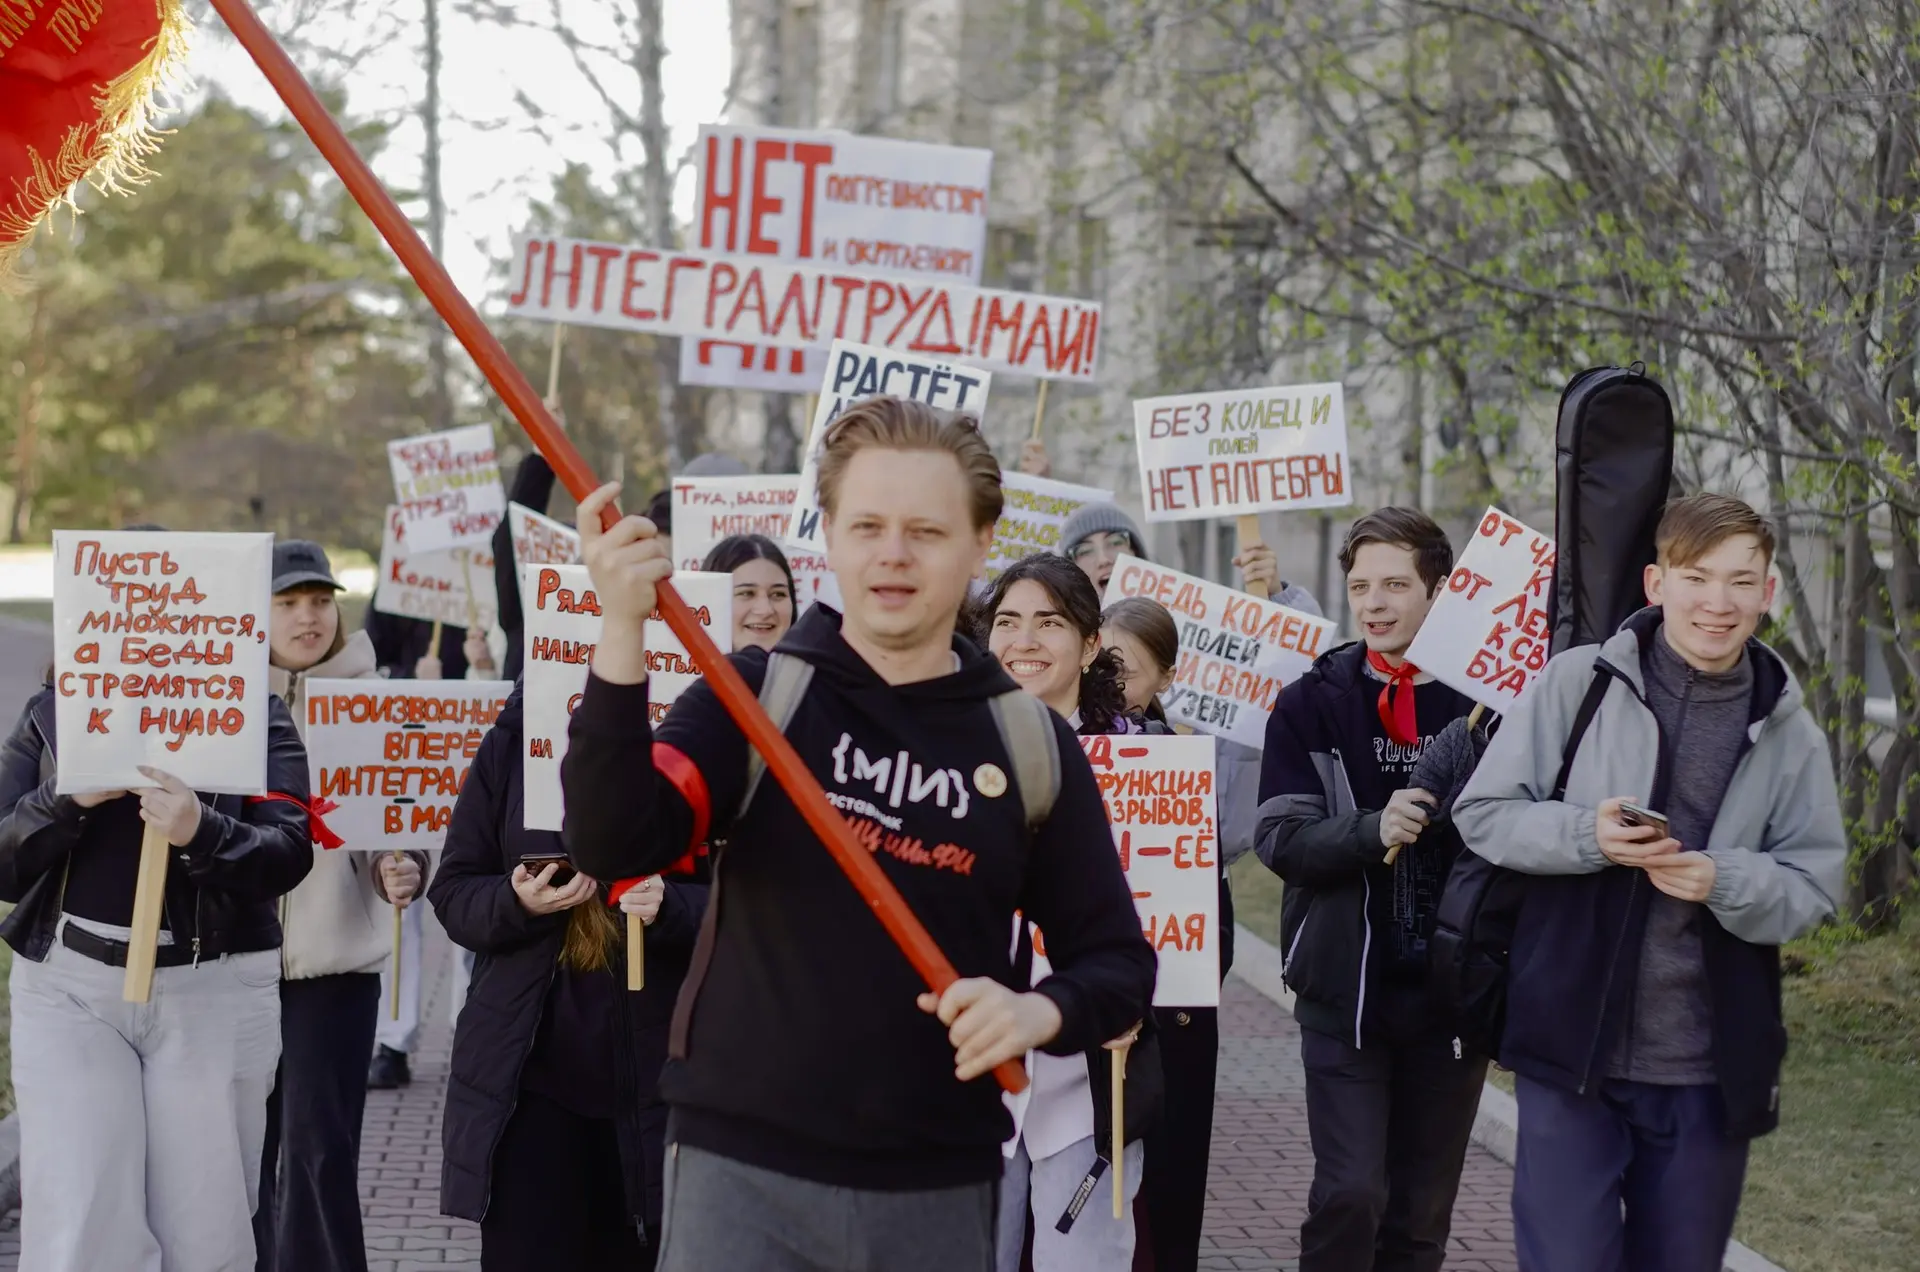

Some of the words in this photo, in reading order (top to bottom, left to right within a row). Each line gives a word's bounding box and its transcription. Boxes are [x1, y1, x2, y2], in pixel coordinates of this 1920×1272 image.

[700, 134, 834, 258] НЕТ
[980, 296, 1100, 376] МАЙ!
[1150, 402, 1212, 439] БЕЗ
[1221, 397, 1302, 433] КОЛЕЦ
[1310, 394, 1332, 426] И
[1208, 432, 1260, 456] ПОЛЕЙ
[1147, 465, 1204, 511] НЕТ
[1210, 452, 1343, 506] АЛГЕБРЫ
[74, 540, 179, 584] Пусть
[1479, 512, 1524, 547] ОТ
[1530, 537, 1557, 572] ЧА
[108, 576, 207, 614] труд
[1119, 565, 1208, 621] СРЕДЬ
[1449, 567, 1493, 601] ОТ
[78, 610, 266, 644] множится,
[1179, 621, 1262, 668] ПОЛЕЙ
[1220, 594, 1322, 660] КОЛЕЦ
[1485, 621, 1511, 650] К
[1508, 636, 1548, 671] СВ
[74, 642, 100, 664] а
[1175, 651, 1201, 686] И
[1465, 648, 1526, 698] БУД
[58, 672, 245, 701] стремятся
[1162, 683, 1240, 731] УЗЕЙ!
[140, 706, 245, 752] нулю
[383, 728, 483, 761] ВПЕРЁ
[384, 805, 404, 834] В
[410, 805, 452, 833] МА
